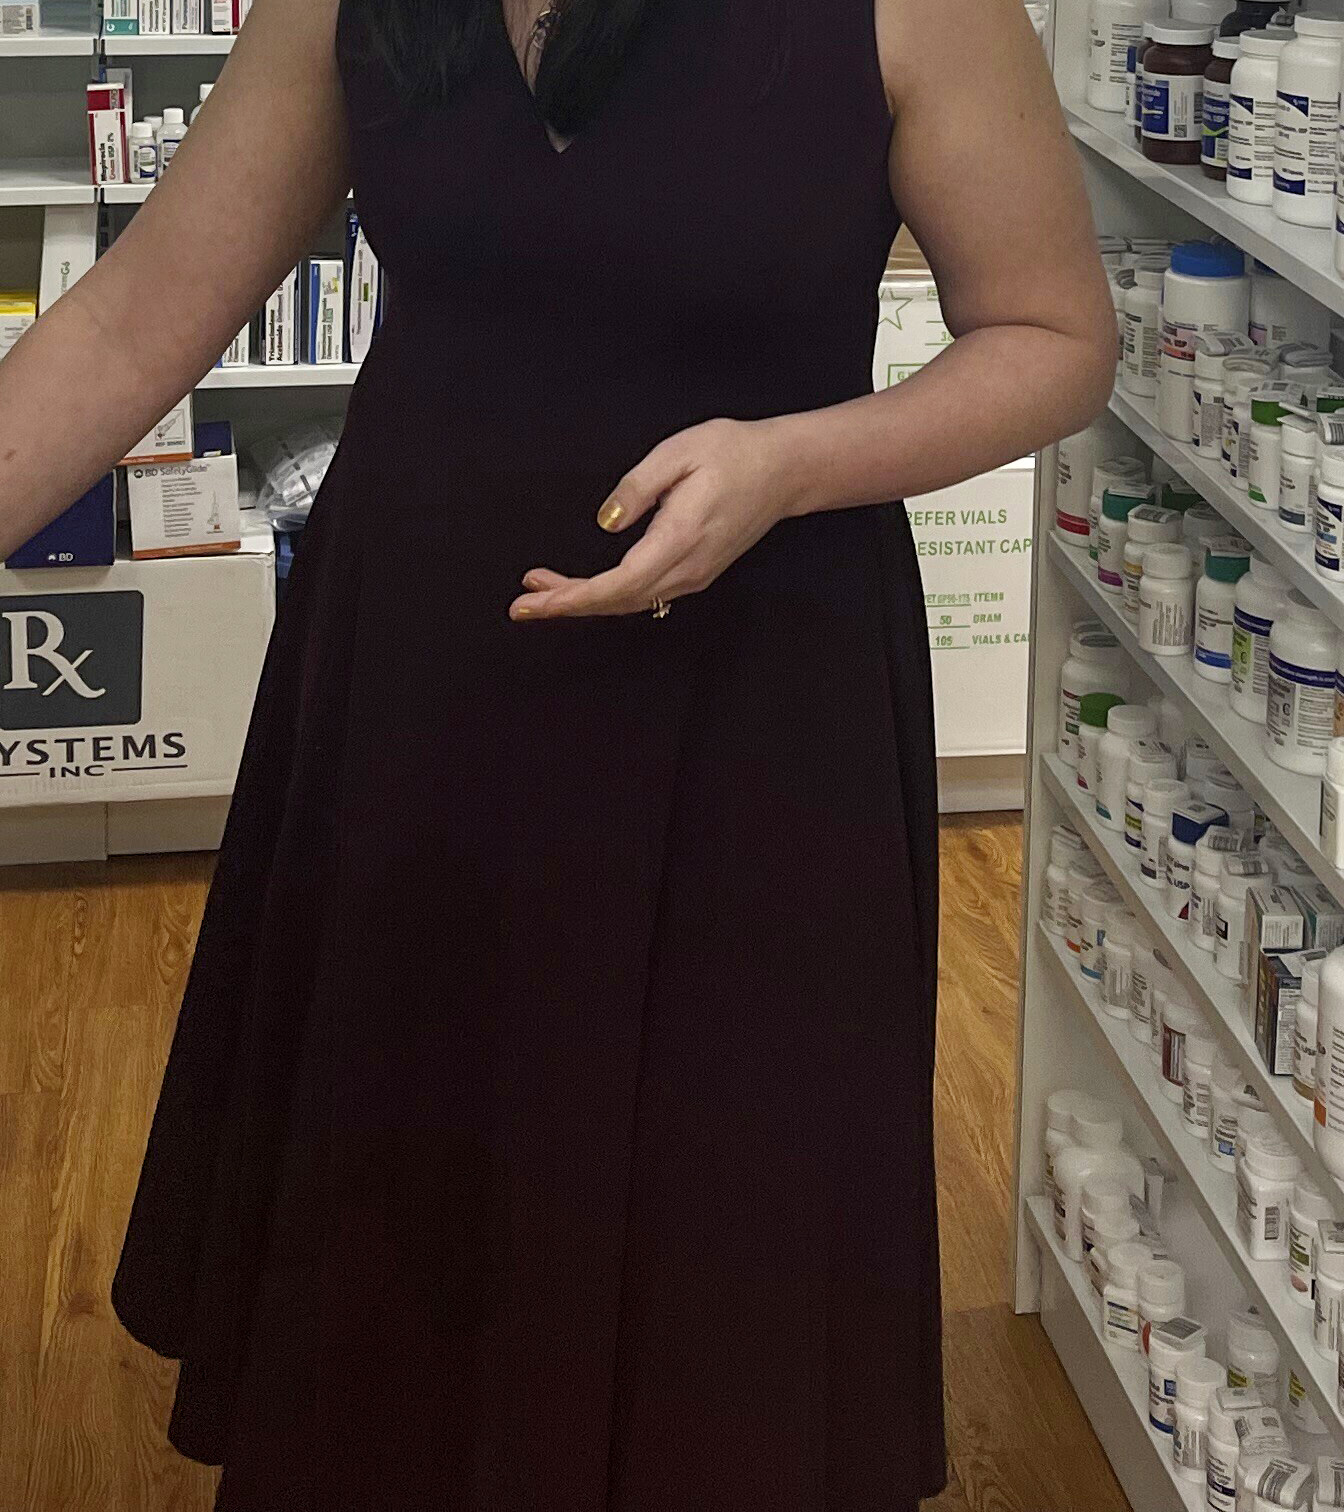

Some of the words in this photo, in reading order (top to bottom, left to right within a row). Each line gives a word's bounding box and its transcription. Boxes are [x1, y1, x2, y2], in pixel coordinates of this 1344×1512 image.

[145, 469, 158, 477] BD
[960, 509, 1007, 525] VIALS
[916, 540, 997, 556] ESISTANT
[59, 553, 73, 561] BD
[940, 615, 952, 625] 50
[973, 612, 1002, 623] DRAM
[972, 634, 1002, 645] VIALS
[2, 610, 106, 699] Rx
[49, 764, 105, 778] INC
